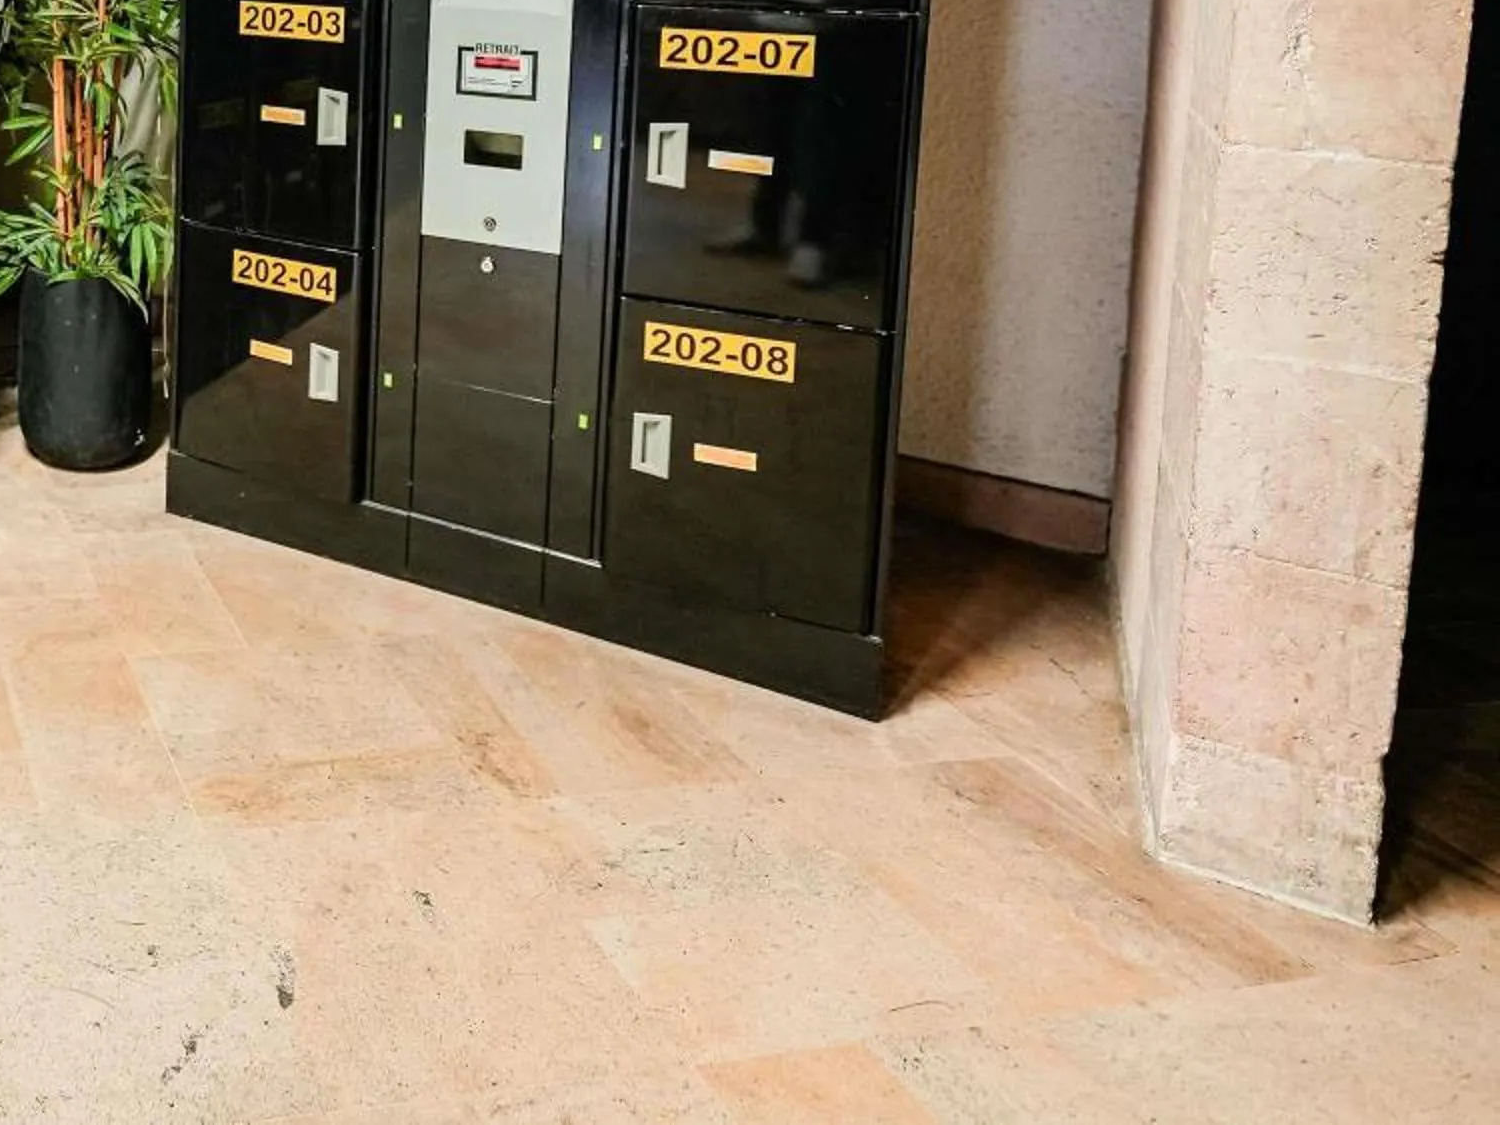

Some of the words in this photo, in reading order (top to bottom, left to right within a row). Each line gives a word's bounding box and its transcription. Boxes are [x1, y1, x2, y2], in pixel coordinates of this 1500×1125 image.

[244, 5, 341, 37] 202-03
[475, 42, 519, 55] RETRAIT
[666, 34, 809, 70] 202-07
[238, 255, 333, 296] 202-04
[650, 329, 789, 376] 202-08
